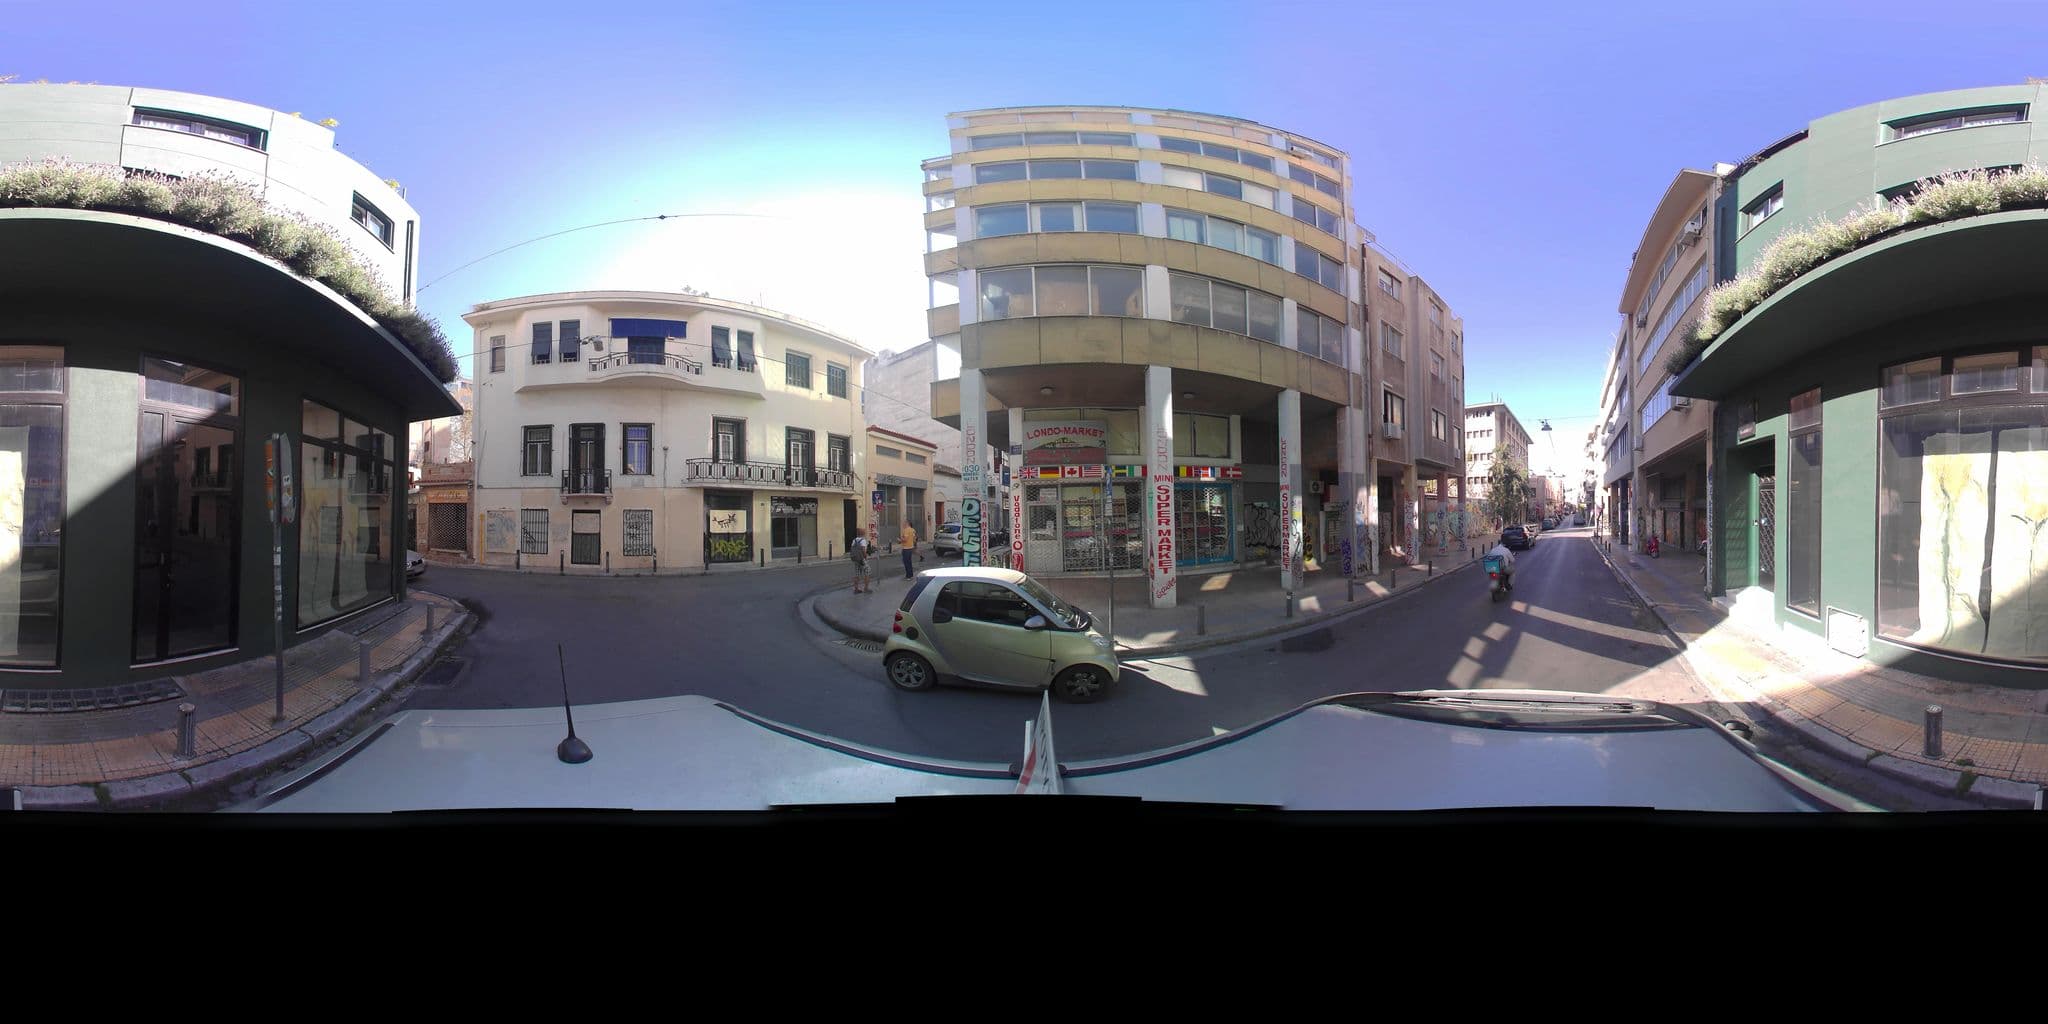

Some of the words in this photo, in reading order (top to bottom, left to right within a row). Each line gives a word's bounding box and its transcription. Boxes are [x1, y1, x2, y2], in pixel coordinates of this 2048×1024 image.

[1026, 427, 1105, 439] LONDO-MARKET
[1157, 485, 1171, 526] SUPER
[1158, 529, 1172, 574] MARKET
